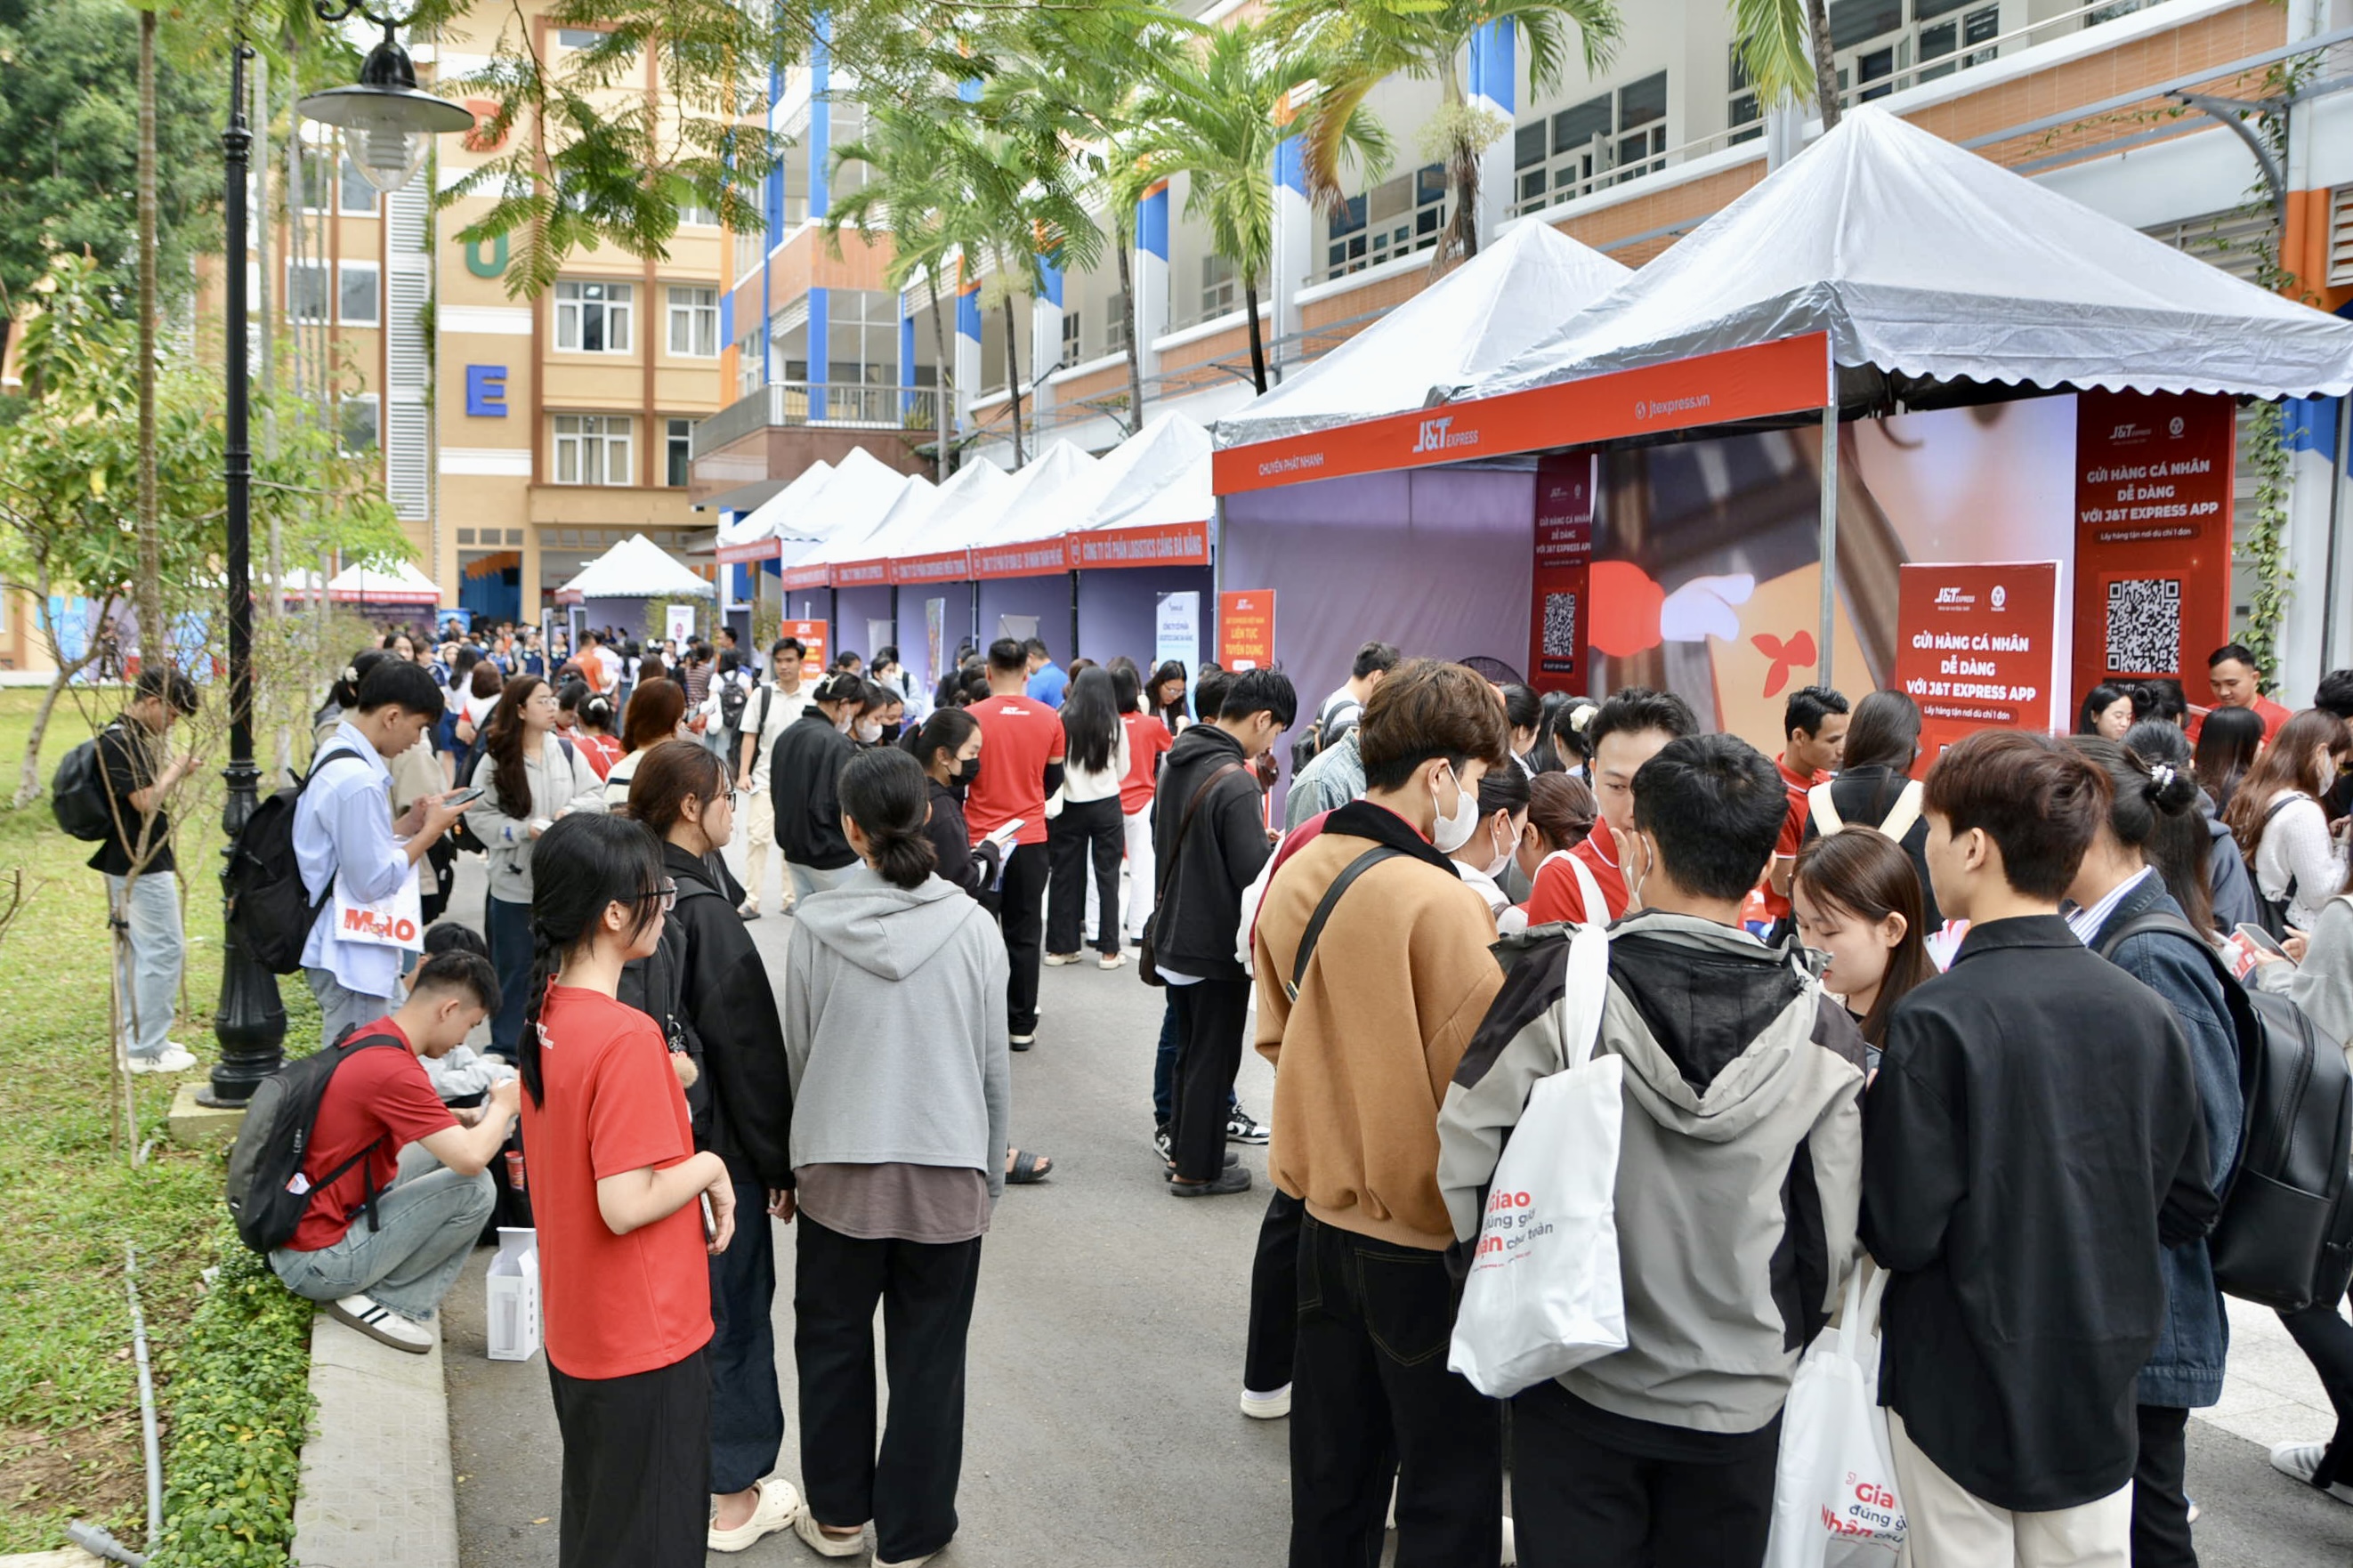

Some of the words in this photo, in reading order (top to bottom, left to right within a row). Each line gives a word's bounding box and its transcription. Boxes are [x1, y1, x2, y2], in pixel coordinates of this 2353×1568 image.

[1648, 394, 1710, 419] jtexpress.vn
[1412, 416, 1453, 453] J&T
[1446, 430, 1479, 448] EXPRESS
[2109, 424, 2136, 440] J&T
[1300, 452, 1324, 469] NHANH
[2087, 466, 2107, 482] GỬI
[2111, 465, 2147, 481] HÀNG
[2149, 461, 2168, 478] CÁ
[2171, 457, 2211, 474] NHÂN
[2117, 484, 2135, 502] DỄ
[2138, 484, 2175, 499] DÀNG
[2081, 508, 2102, 523] VỚI
[2105, 508, 2127, 521] J&T
[2130, 505, 2187, 520] EXPRESS
[2190, 502, 2219, 516] APP
[1128, 538, 1156, 559] LOGISTICS
[1934, 587, 1961, 603] J&T
[1231, 626, 1244, 639] LIÊN
[1912, 630, 1933, 649] GỬI
[1935, 632, 1969, 651] HÀNG
[1972, 634, 1989, 651] CÁ
[1992, 634, 2029, 651] NHÂN
[1941, 654, 1958, 675] DỄ
[1960, 659, 1995, 676] DÀNG
[1906, 677, 1927, 695] VỚI
[1928, 682, 1951, 696] J&T
[1953, 682, 2007, 700] EXPRESS
[2009, 686, 2036, 701] APP
[1924, 705, 1935, 715] Lấy
[1935, 706, 1951, 717] hàng
[1951, 707, 1961, 717] tận
[1997, 711, 2009, 720] đơn
[1821, 1502, 1873, 1538] Nhận
[1849, 1504, 1891, 1527] đúng
